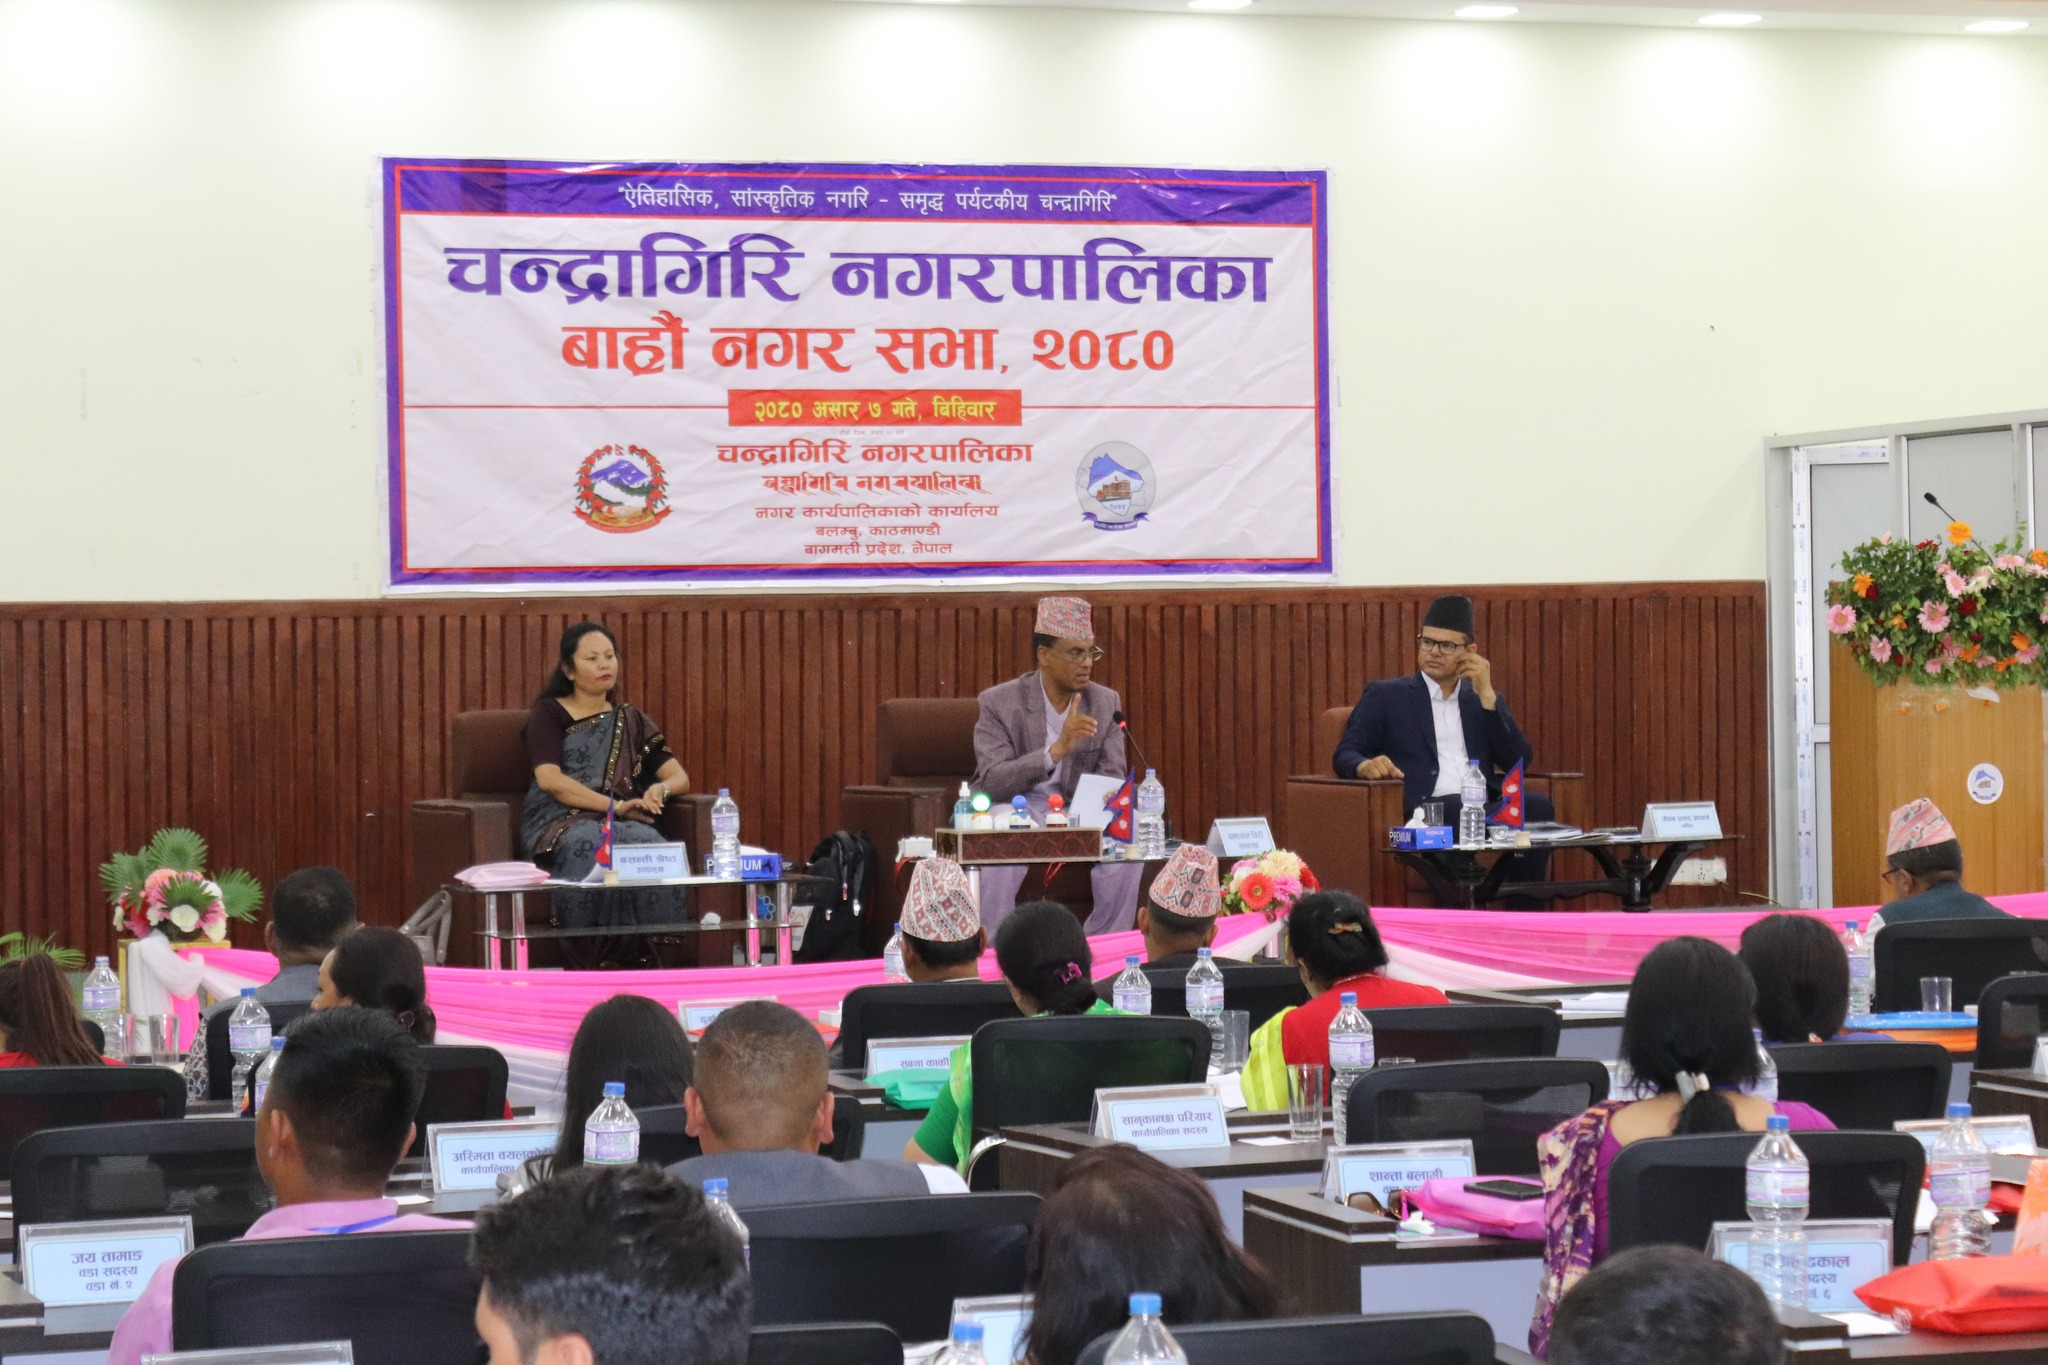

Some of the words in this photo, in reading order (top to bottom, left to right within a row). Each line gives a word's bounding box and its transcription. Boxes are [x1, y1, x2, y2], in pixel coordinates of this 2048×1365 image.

[730, 185, 815, 213] सांस्कृतिक
[826, 188, 869, 209] नगरि
[899, 192, 943, 215] समृद्ध
[956, 189, 1028, 212] पर्यटकीय
[444, 231, 804, 305] चन्द्रागिरि
[830, 237, 1273, 304] नगरपालिका
[710, 328, 855, 373] नगर
[875, 327, 1009, 374] सभा,
[1032, 329, 1174, 372] २०८०
[755, 401, 802, 422] २०८०
[812, 401, 861, 420] असार
[868, 401, 881, 418] ७
[892, 397, 922, 422] गते,
[932, 396, 997, 422] बिहिवार
[717, 438, 851, 466] चन्द्रागिरि
[860, 438, 1033, 464] नगरपालिका
[755, 506, 795, 519] नगर
[802, 502, 922, 519] कार्यपालिकाको
[928, 502, 999, 518] कार्यालय
[804, 541, 861, 555] बागमती
[912, 541, 953, 554] नेपाल
[1389, 831, 1411, 843] PREMIUM
[706, 859, 762, 871] PIUM
[1176, 1111, 1213, 1123] परियार
[1131, 1127, 1179, 1137] कार्यपालिका
[1182, 1126, 1208, 1136] सदस्य
[452, 1150, 494, 1162] अस्मिता
[1369, 1170, 1402, 1182] शान्ता
[1406, 1168, 1443, 1181] बलामी
[71, 1252, 97, 1264] जय
[79, 1268, 99, 1278] वडा
[103, 1266, 138, 1277] सदस्य
[85, 1282, 105, 1291] वडा
